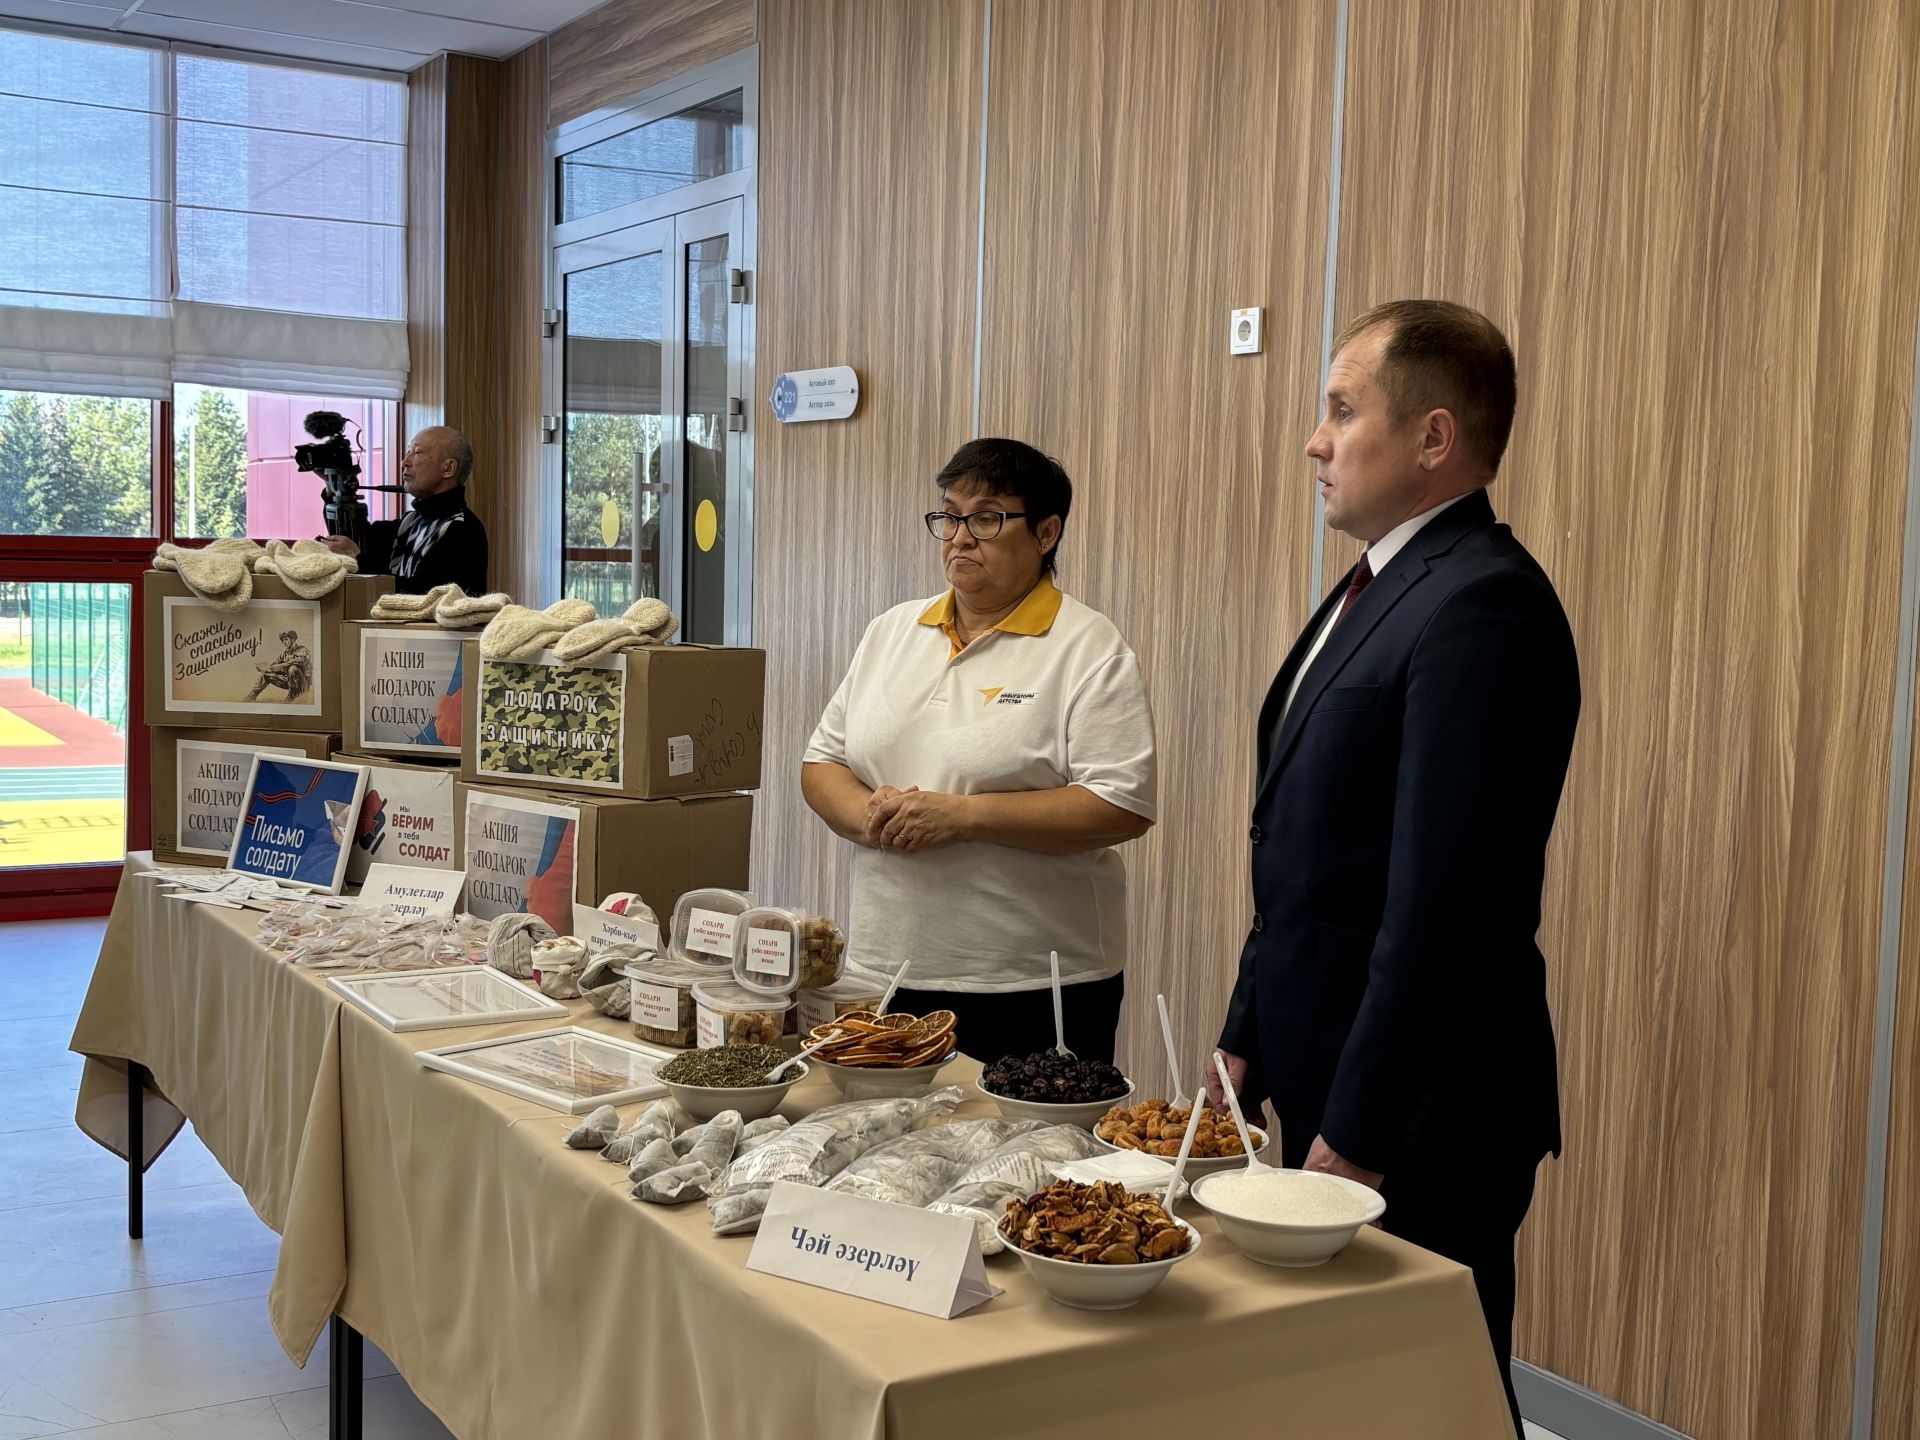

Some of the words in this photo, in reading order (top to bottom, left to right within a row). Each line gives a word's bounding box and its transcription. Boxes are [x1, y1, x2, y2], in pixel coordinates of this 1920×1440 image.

[784, 391, 796, 404] 221
[174, 620, 226, 650] Скажи
[190, 624, 242, 659] спасибо
[174, 628, 262, 681] Защитнику!
[381, 651, 425, 670] АКЦИЯ
[370, 678, 436, 698] «ПОДАРОК
[504, 690, 598, 714] ПОДАРОК
[371, 706, 434, 725] СОЛДАТУ»
[486, 723, 612, 752] ЗАЩИТНИКУ
[197, 762, 240, 782] АКЦИЯ
[188, 814, 238, 833] СОЛДАТ
[251, 815, 305, 848] Письмо
[392, 814, 434, 832] ВЕРИМ
[481, 820, 518, 844] АКЦИЯ
[404, 832, 420, 841] тебя
[245, 846, 302, 880] солдату
[398, 842, 450, 862] СОЛДАТ
[472, 850, 527, 876] «ПОДАРОК
[384, 884, 444, 902] Амулетлар
[473, 880, 528, 908] СОЛДАТУ»
[391, 904, 428, 918] зерләү
[791, 1226, 832, 1256] Чәй
[836, 1243, 920, 1282] әзерләү
